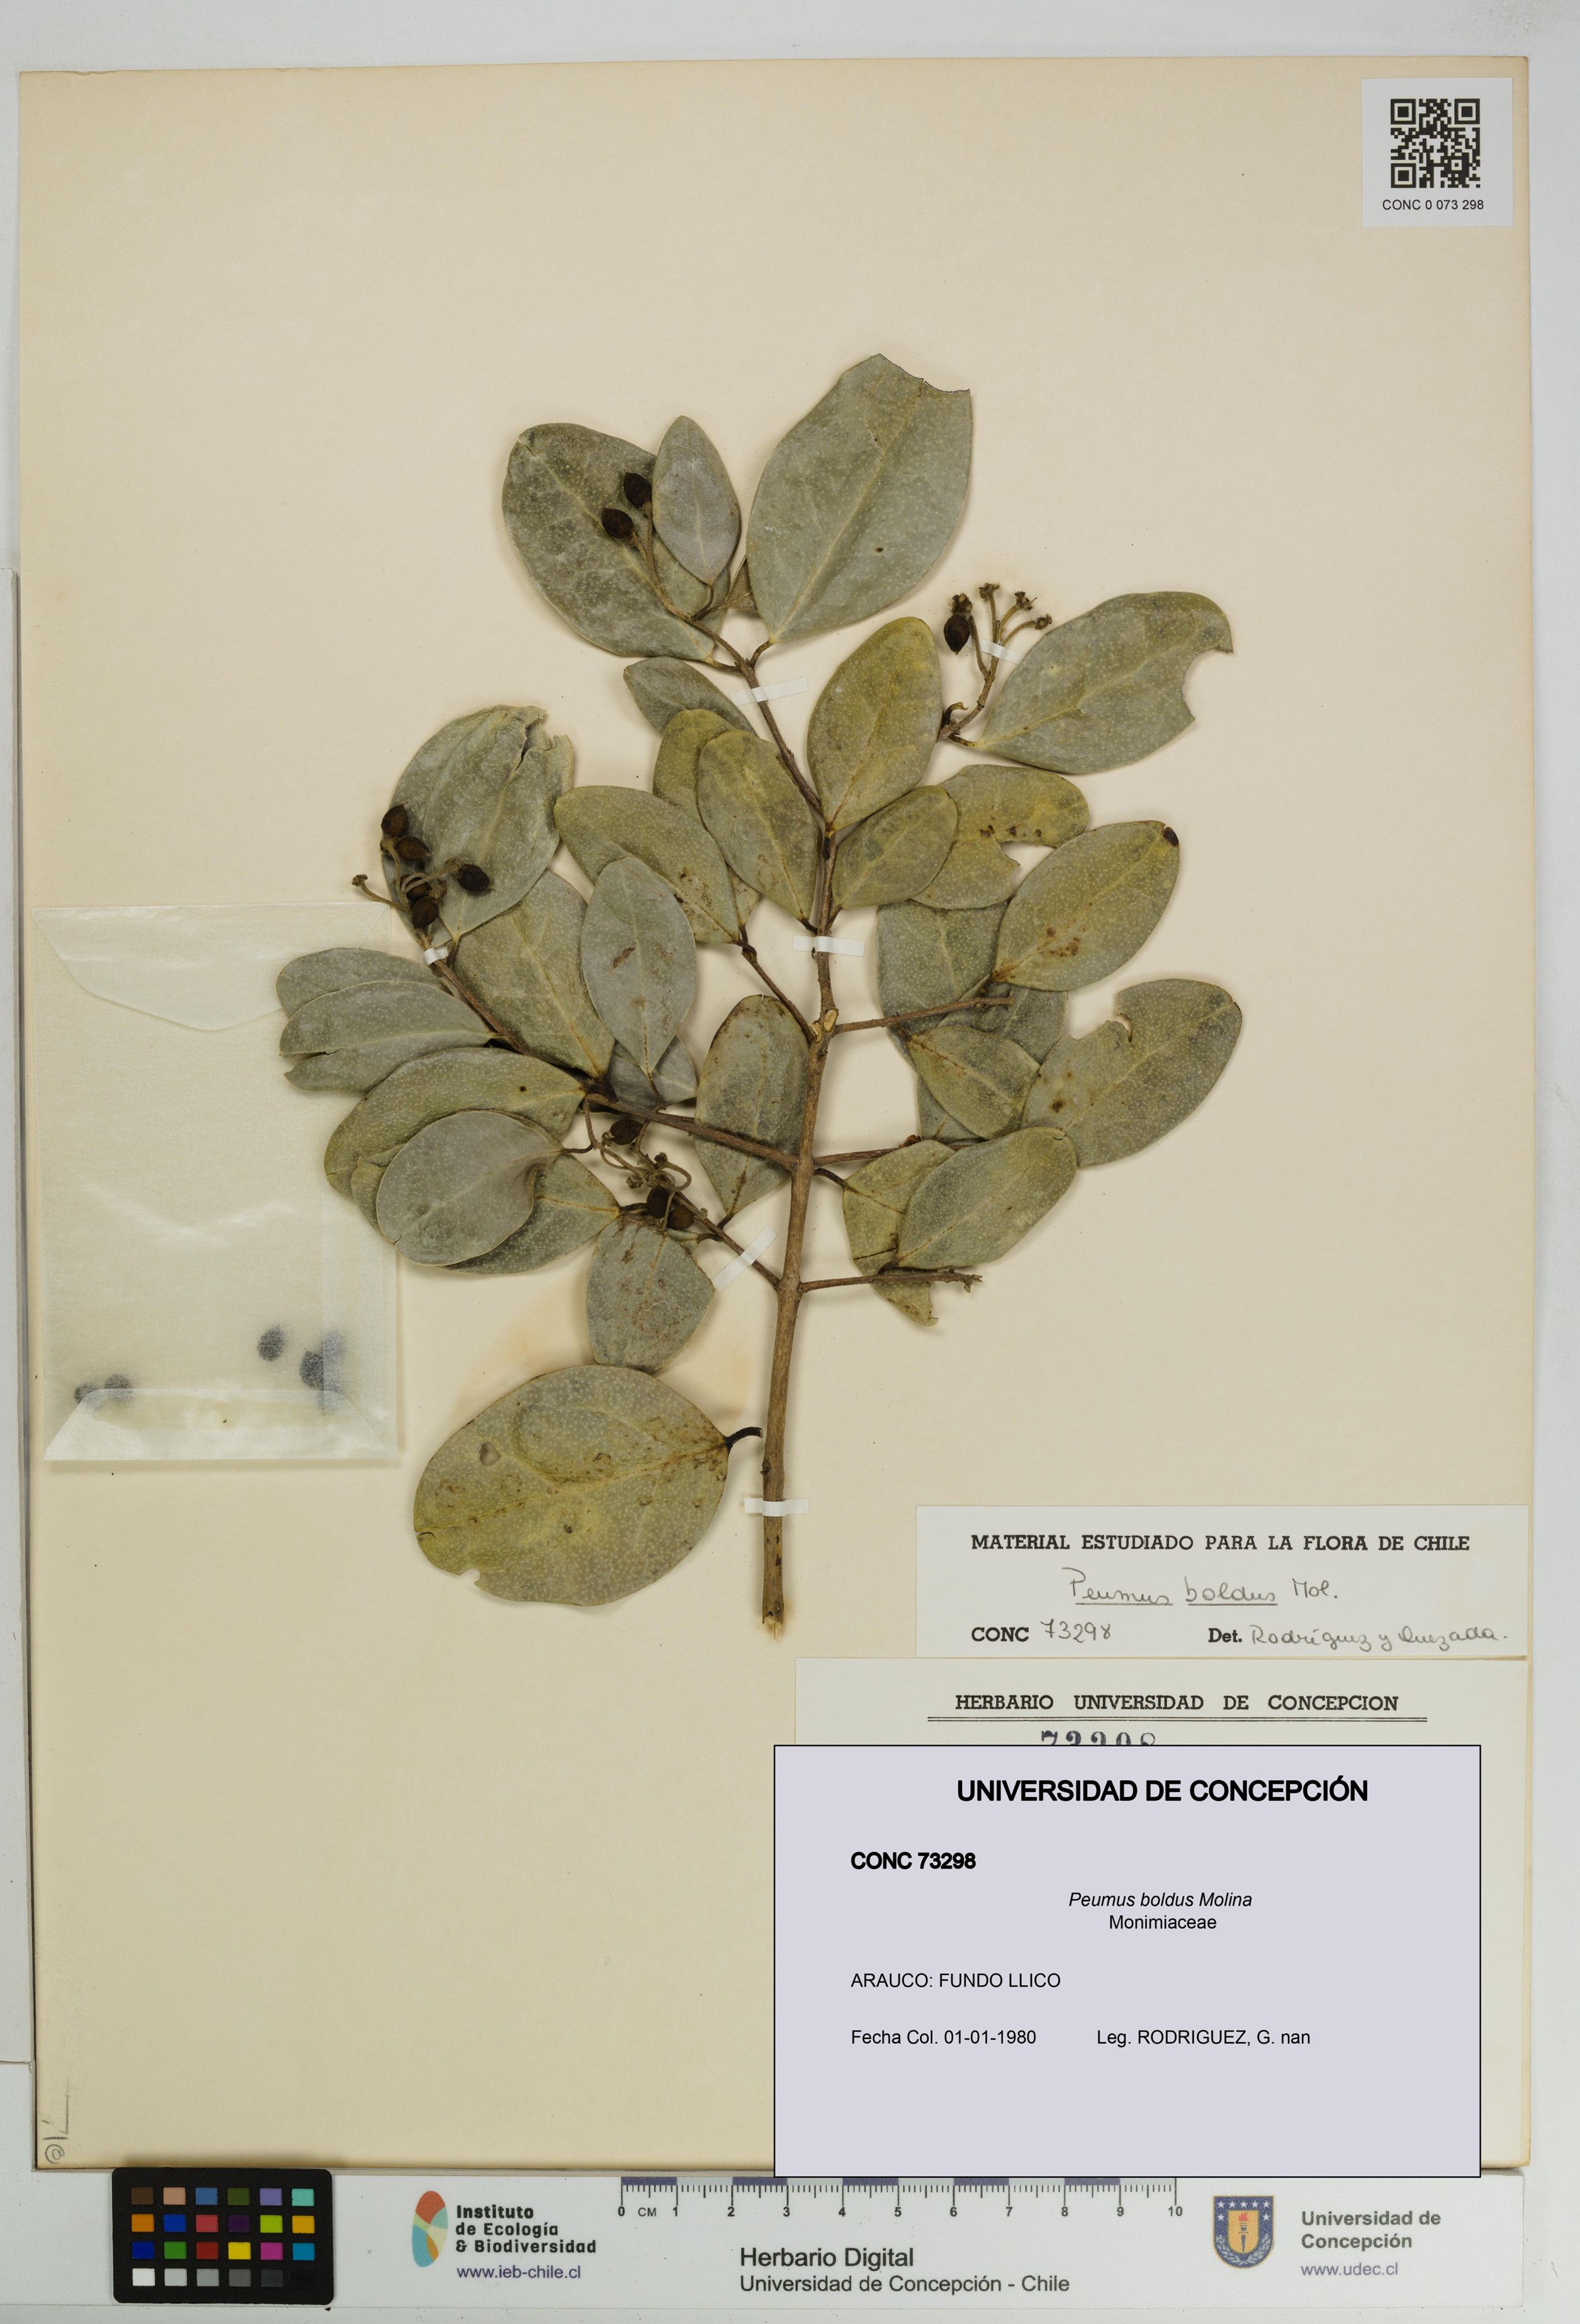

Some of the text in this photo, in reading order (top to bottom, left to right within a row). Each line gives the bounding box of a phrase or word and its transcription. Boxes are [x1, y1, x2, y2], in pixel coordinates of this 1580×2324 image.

[1382, 199, 1484, 210] CONC 0 073 298
[971, 1534, 1470, 1551] MATERIAL ESTUDIADO PARA LA FLORA DE CHILE
[1062, 1567, 1338, 1605] Peumus boldus Mol.
[971, 1619, 1111, 1643] CONC 73298
[1208, 1628, 1243, 1643] Det.
[1379, 1634, 1392, 1652] y
[956, 1695, 1399, 1711] HERBARIO UNIVERSIDAD DE CONCEPCION
[456, 2204, 534, 2219] Instituto
[617, 2206, 1183, 2217] 0 CM 1 2 3 4 5 6 7 8 9 10
[1301, 2210, 1441, 2226] Universidad de
[456, 2222, 559, 2238] de Ecología
[456, 2239, 596, 2254] & Biodiversidad
[1301, 2232, 1413, 2252] Concepción
[741, 2247, 914, 2270] Herbario Digital
[456, 2265, 581, 2279] www.ieb-chile.cl
[1301, 2261, 1398, 2276] www.udec.cl
[740, 2275, 852, 2292] Universidad
[860, 2275, 882, 2292] de
[889, 2275, 1002, 2296] Concepción
[1021, 2275, 1070, 2292] Chile
